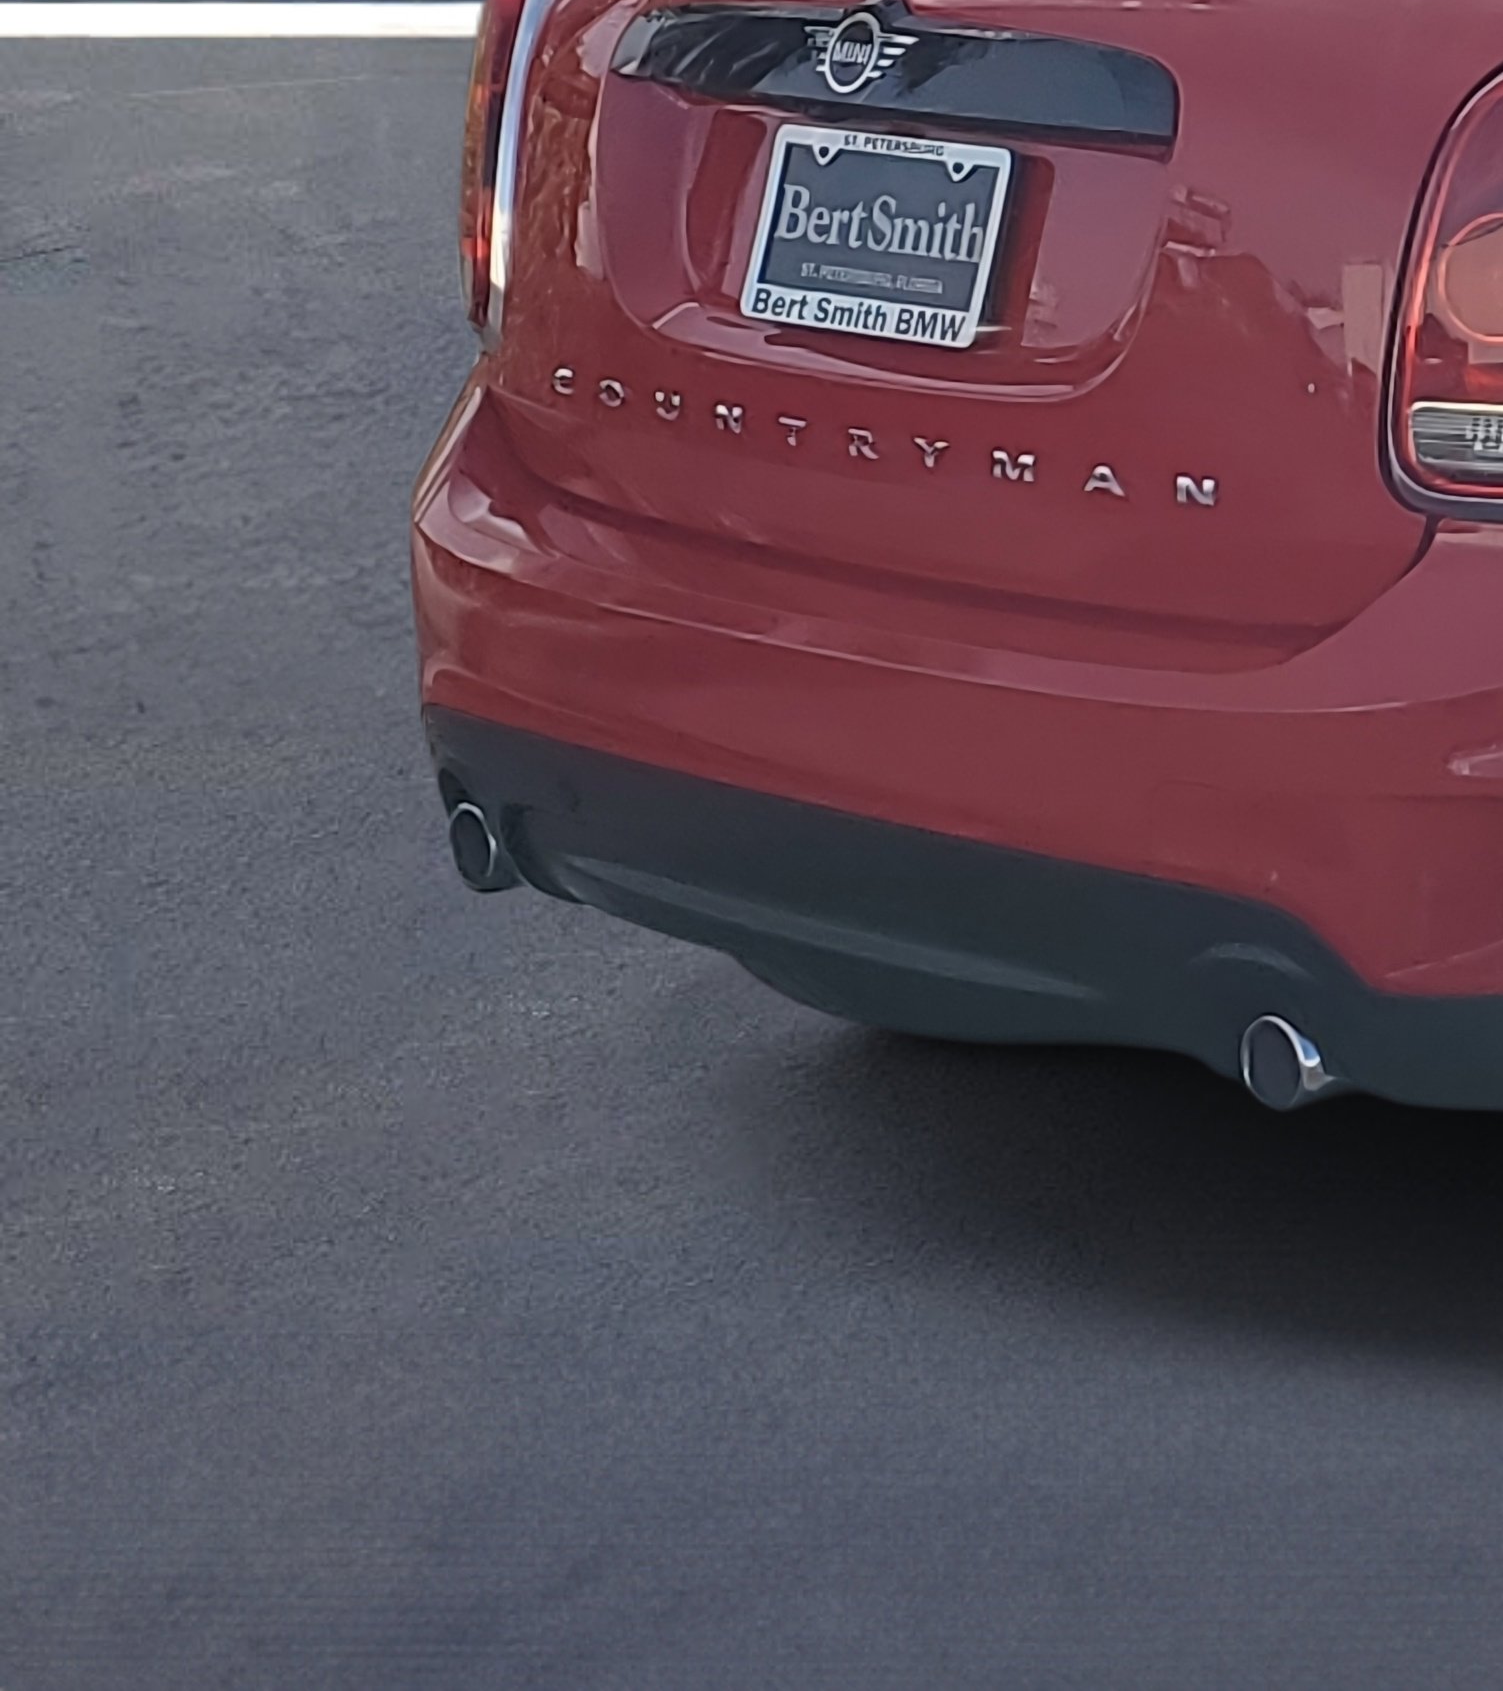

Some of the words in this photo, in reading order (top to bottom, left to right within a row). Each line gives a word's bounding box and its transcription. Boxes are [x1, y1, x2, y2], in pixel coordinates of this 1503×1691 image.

[831, 40, 873, 66] MINI
[751, 288, 809, 321] Bert
[812, 296, 888, 333] Smith
[894, 307, 967, 343] BMW
[551, 366, 1219, 507] COUNTRYMAN
